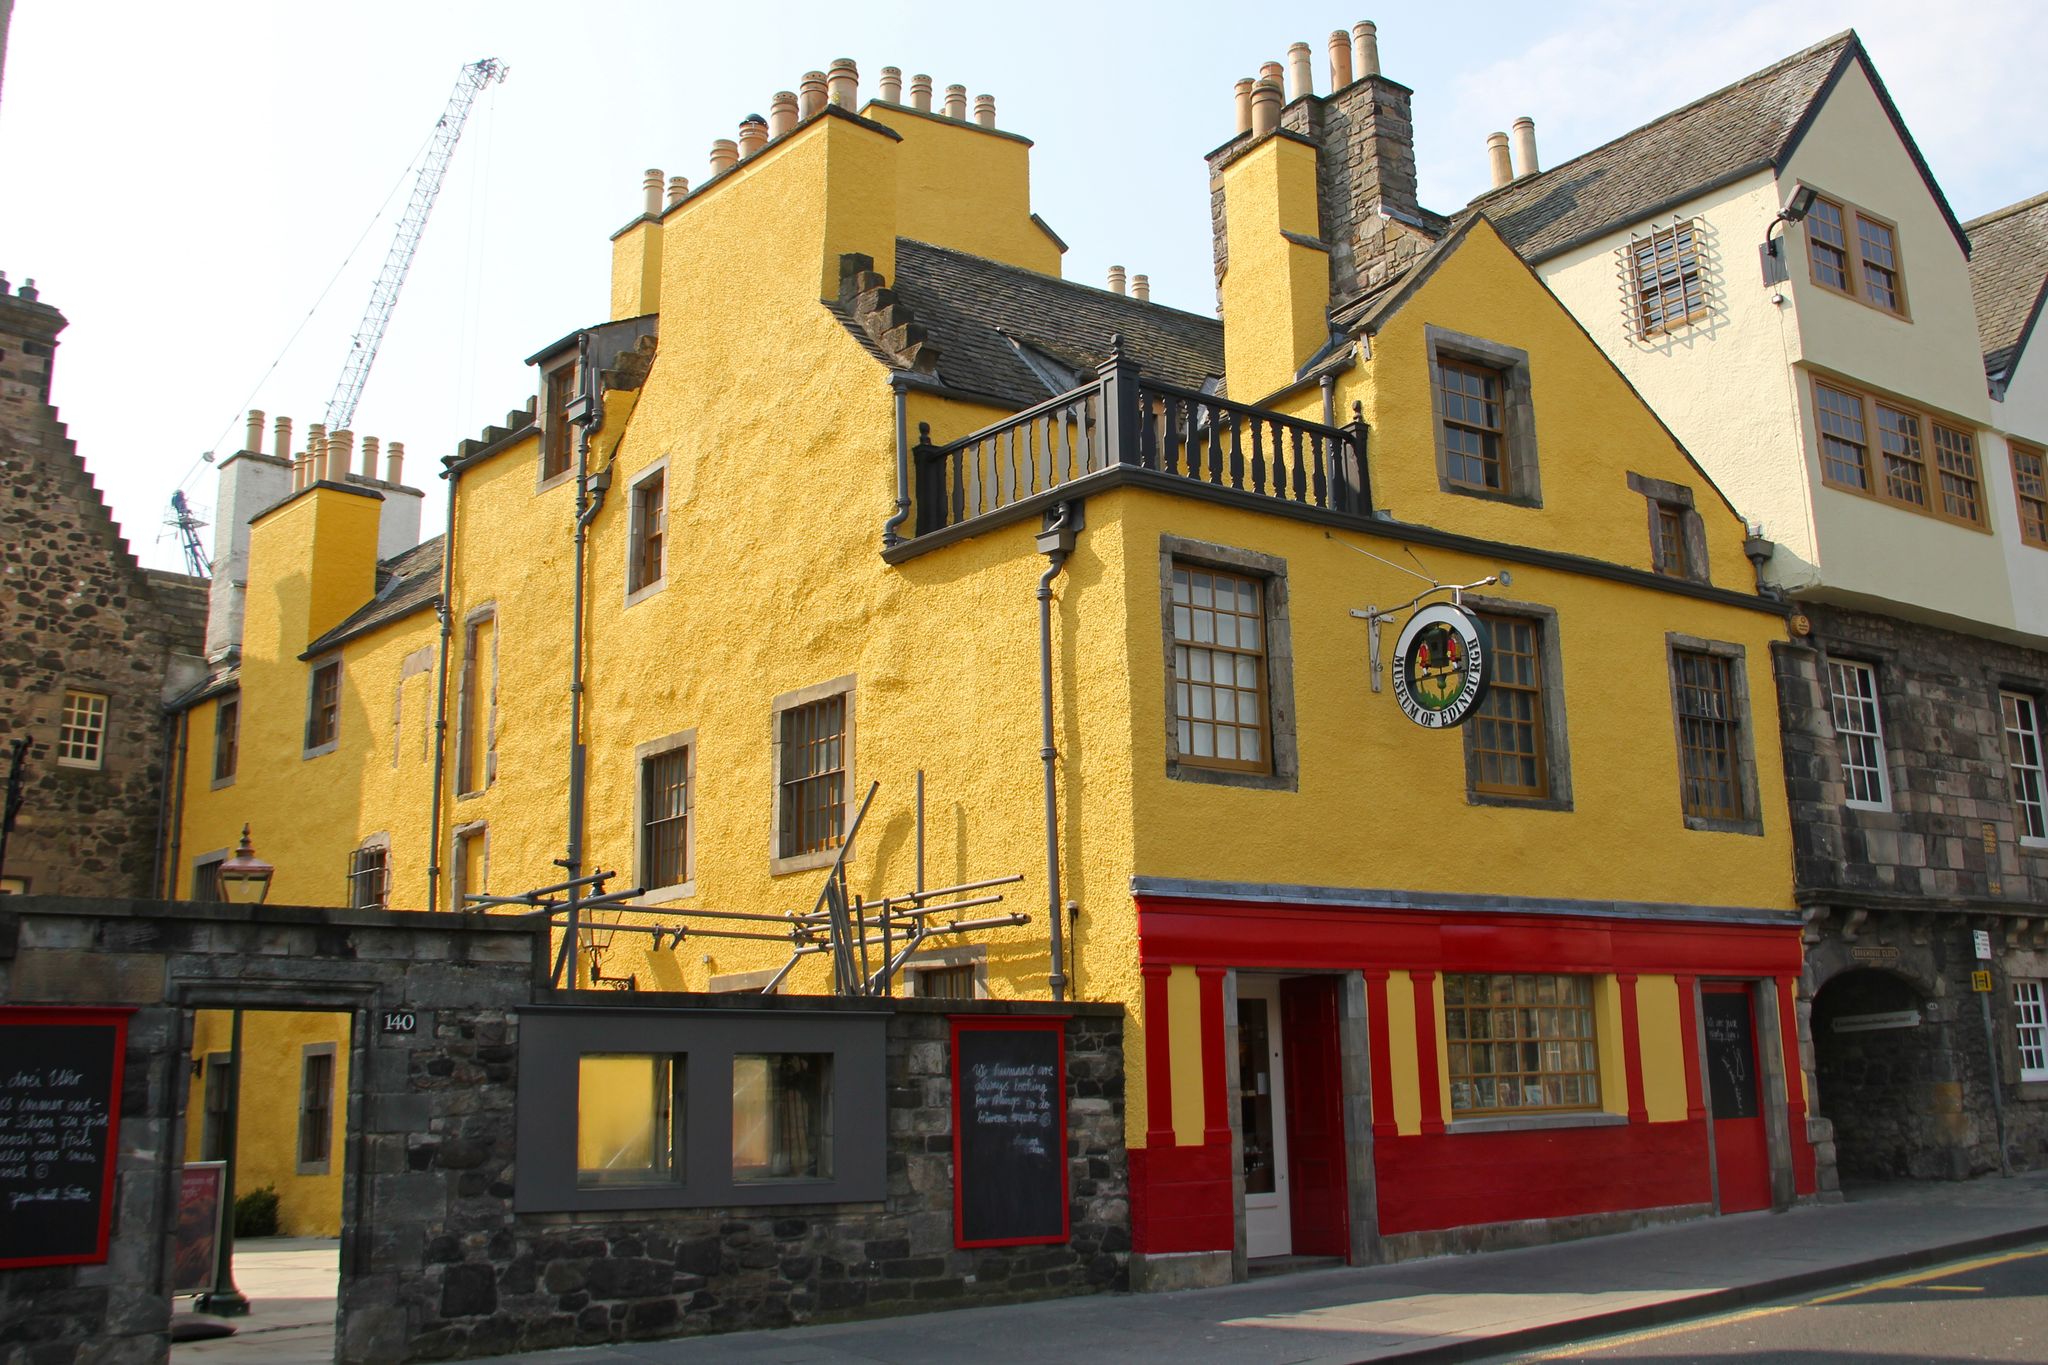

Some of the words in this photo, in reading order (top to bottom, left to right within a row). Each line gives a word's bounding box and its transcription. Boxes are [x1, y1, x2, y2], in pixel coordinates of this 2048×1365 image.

[1393, 655, 1420, 720] MUSEUM
[1420, 711, 1436, 726] OF
[1440, 637, 1481, 726] EDINBURGH
[384, 1013, 415, 1030] 140
[994, 1063, 1034, 1077] humans
[975, 1077, 1009, 1097] always
[1014, 1078, 1048, 1100] looking
